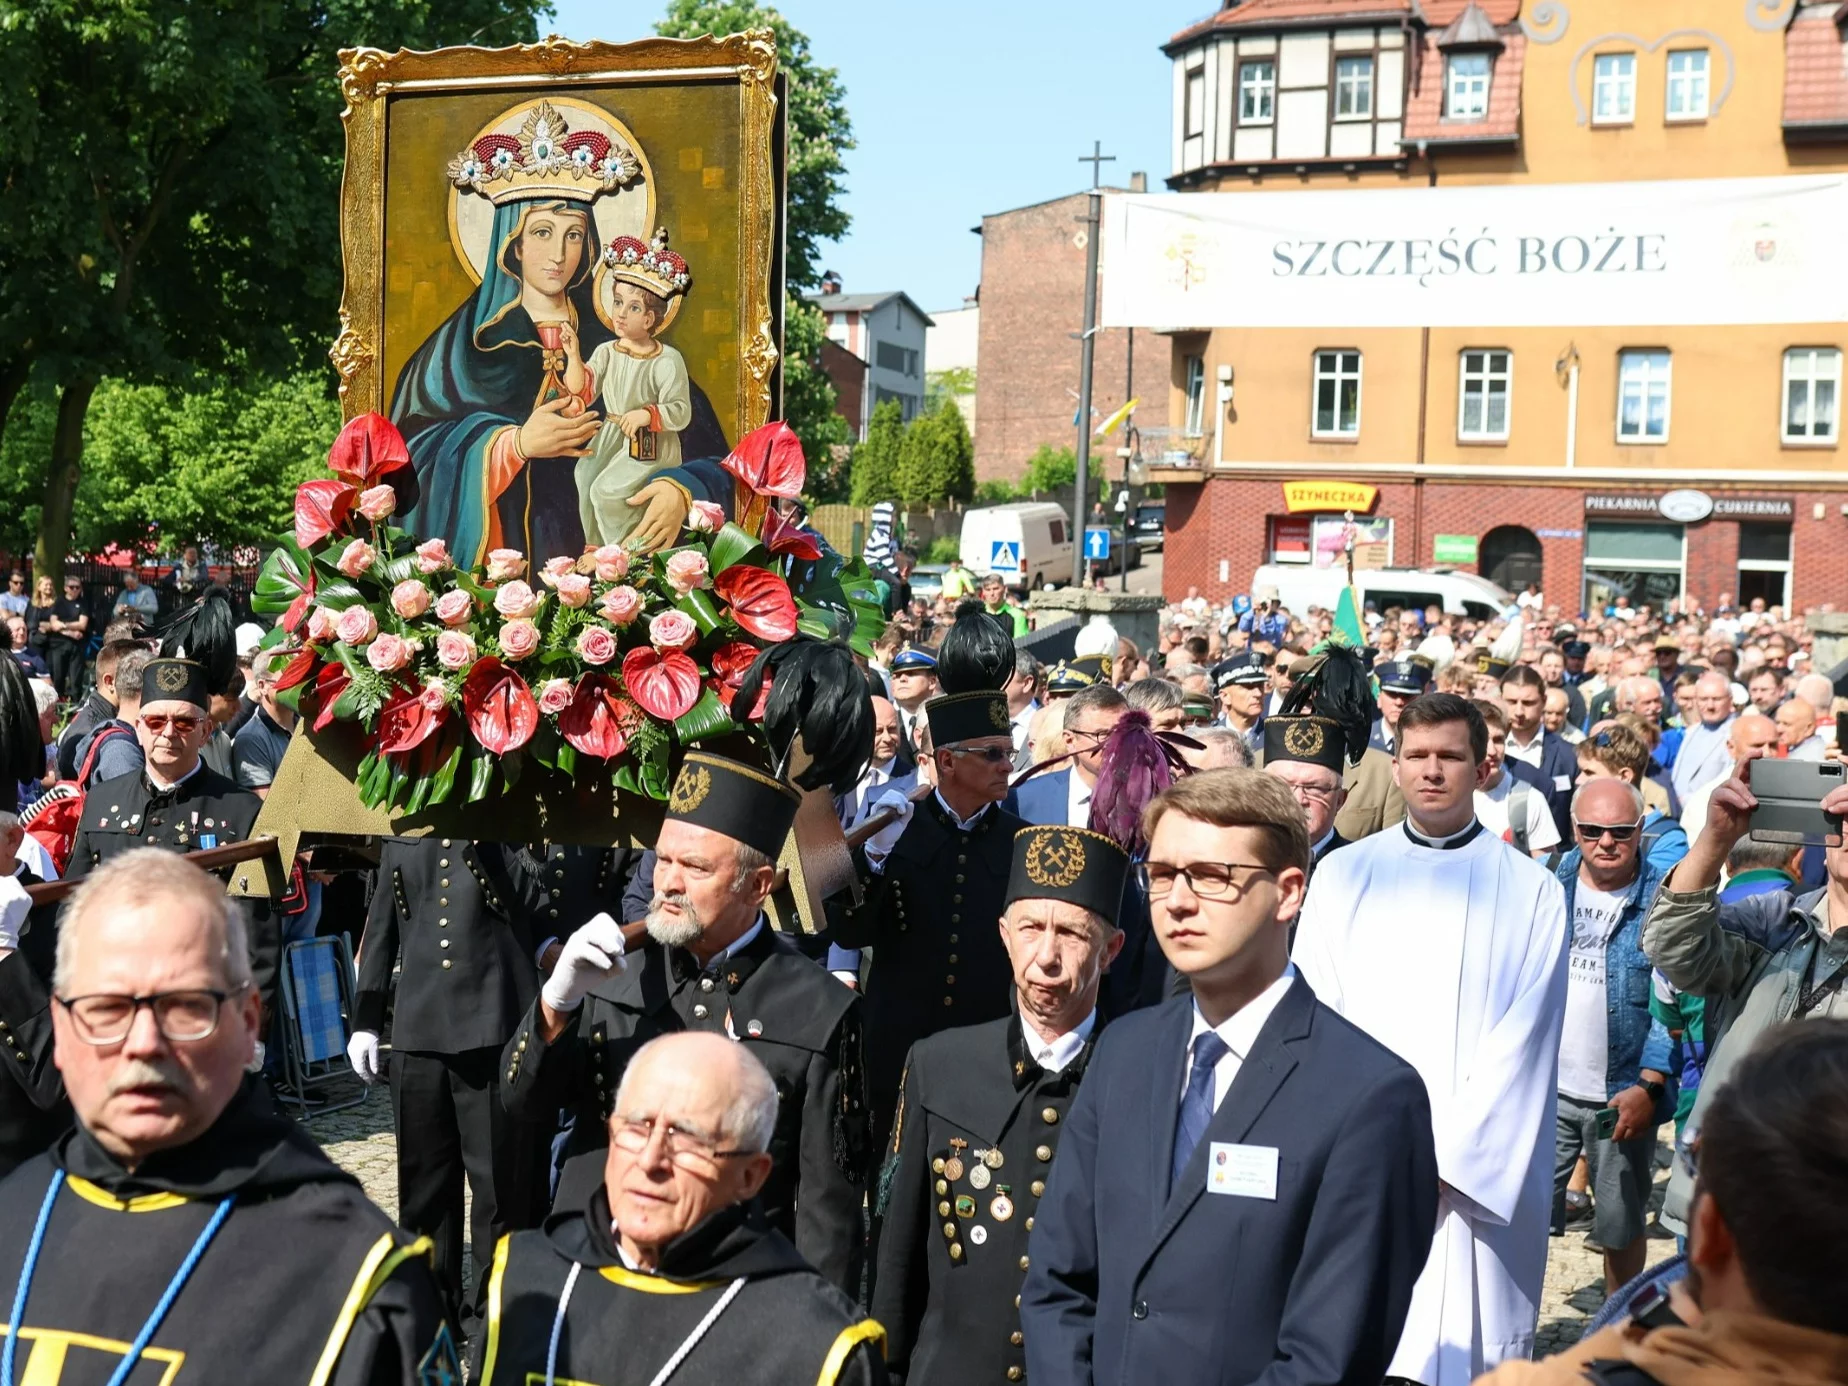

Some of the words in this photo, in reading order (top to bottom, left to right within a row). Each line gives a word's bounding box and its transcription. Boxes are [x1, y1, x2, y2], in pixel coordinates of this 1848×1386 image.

[1271, 226, 1498, 288] SZCZĘŚĆ
[1515, 225, 1668, 275] BOŻE
[1292, 489, 1366, 503] SZYNECZKA
[1586, 496, 1657, 512] PIEKARNIA
[1714, 500, 1792, 515] CUKIERNIA
[1805, 986, 1829, 1007] SONY
